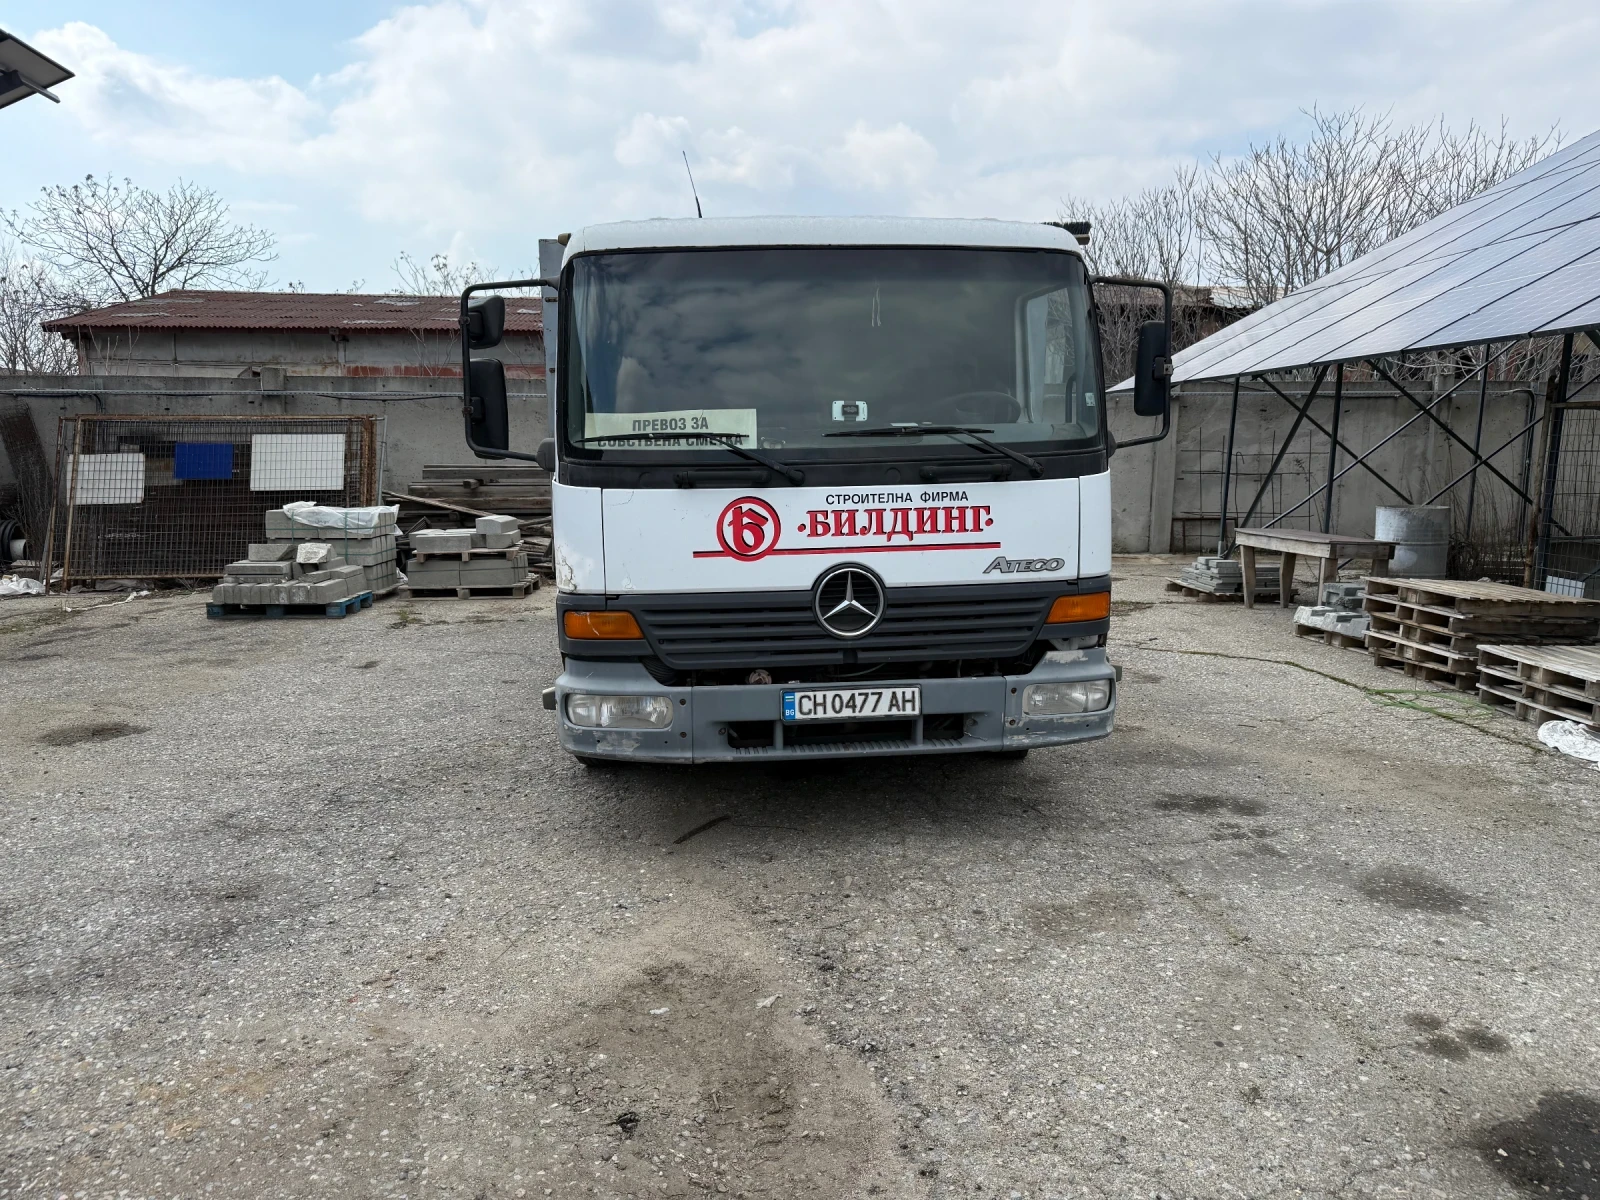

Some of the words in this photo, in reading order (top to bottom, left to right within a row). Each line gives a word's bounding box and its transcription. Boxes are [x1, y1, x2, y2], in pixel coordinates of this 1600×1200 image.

[632, 417, 687, 432] ПРЕВОЗ
[691, 416, 709, 430] ЗА
[825, 492, 913, 505] СТРОИТЕЛНА
[920, 490, 969, 503] ФИРМА
